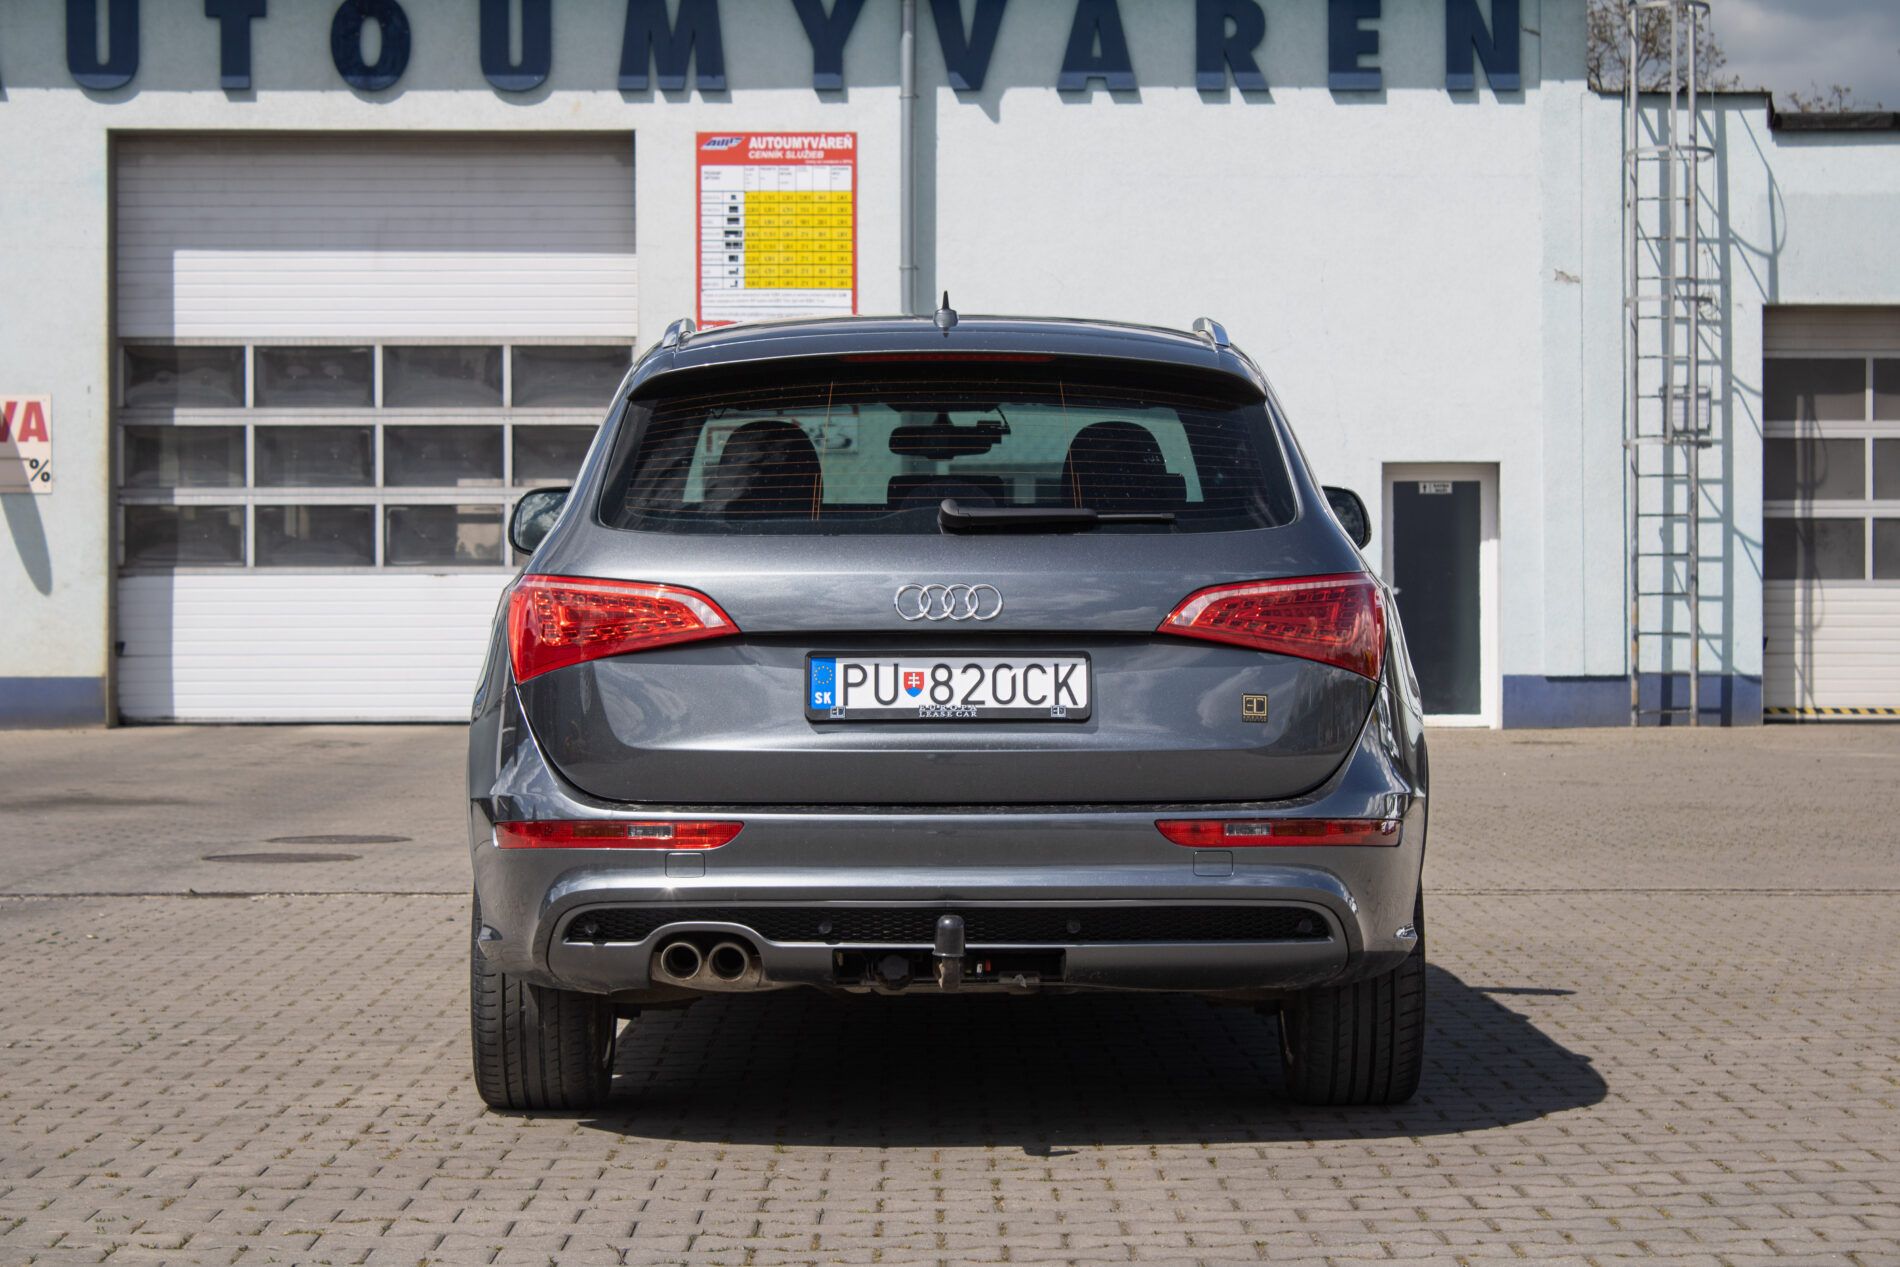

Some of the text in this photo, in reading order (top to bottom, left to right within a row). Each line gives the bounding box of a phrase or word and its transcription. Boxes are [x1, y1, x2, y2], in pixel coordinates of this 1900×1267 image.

[815, 692, 831, 705] SK
[843, 663, 1079, 706] PU 820CK
